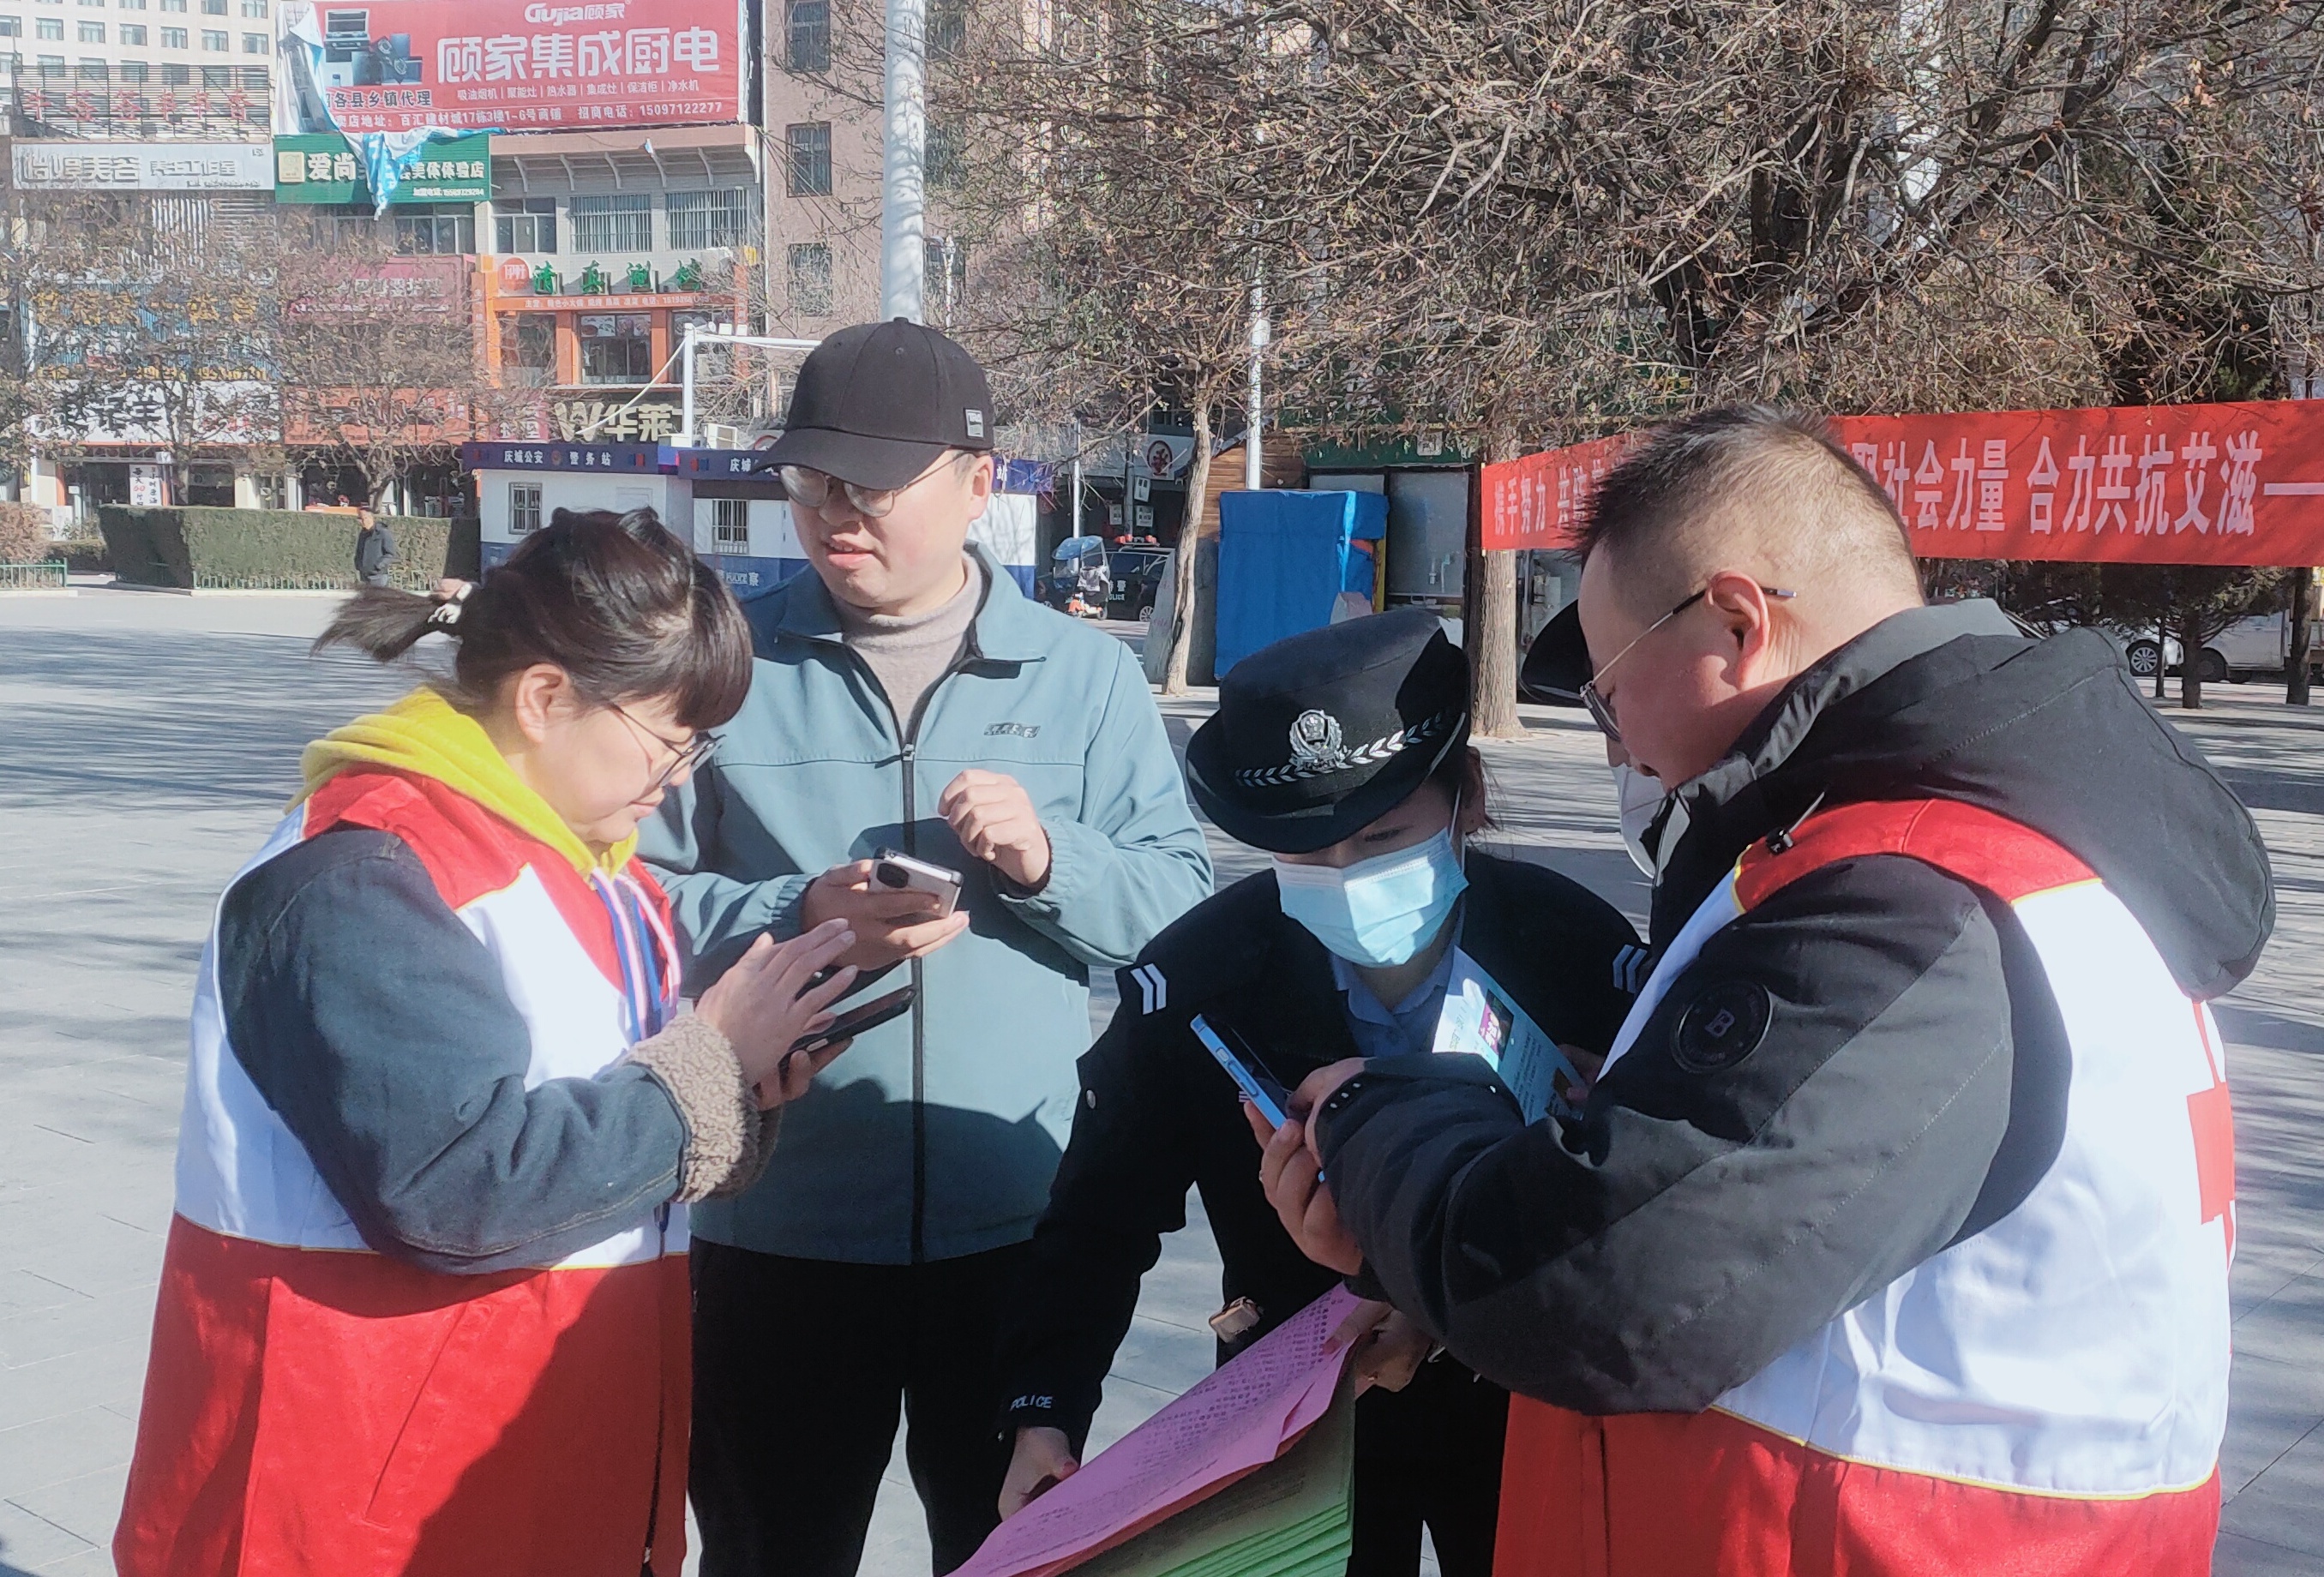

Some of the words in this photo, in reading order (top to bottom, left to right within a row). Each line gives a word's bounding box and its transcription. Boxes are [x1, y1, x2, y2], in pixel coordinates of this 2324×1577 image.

[437, 26, 720, 83] 顾家集成厨电
[586, 83, 617, 96] 集成灶
[668, 79, 700, 93] 净水机
[640, 101, 722, 117] 15097122277
[308, 153, 366, 181] 爱尚
[504, 450, 543, 465] 庆城公安
[570, 451, 611, 467] 警务站
[1494, 471, 1546, 536] 携手努力
[1010, 1394, 1054, 1412] POLICE
